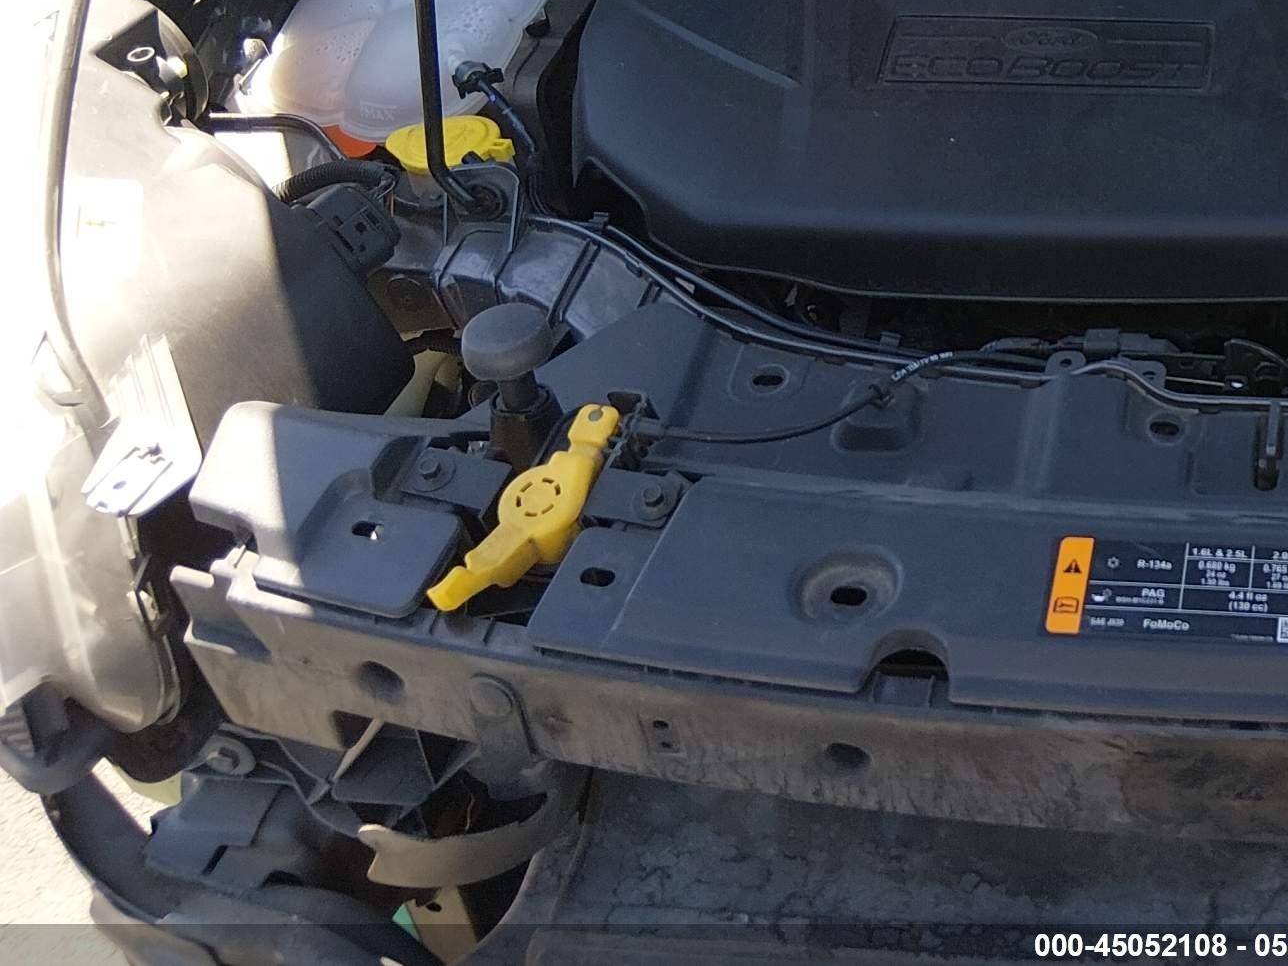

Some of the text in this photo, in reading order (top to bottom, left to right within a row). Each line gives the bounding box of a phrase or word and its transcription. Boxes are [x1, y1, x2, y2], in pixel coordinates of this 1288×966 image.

[1137, 559, 1172, 570] R-134a
[1224, 562, 1236, 573] kg
[1263, 564, 1288, 574] 0.765
[1141, 588, 1165, 598] PAG
[1229, 591, 1245, 600] 4.4
[1255, 594, 1268, 602] oz
[1251, 603, 1268, 613] cc)
[1143, 618, 1190, 631] FoMoCo
